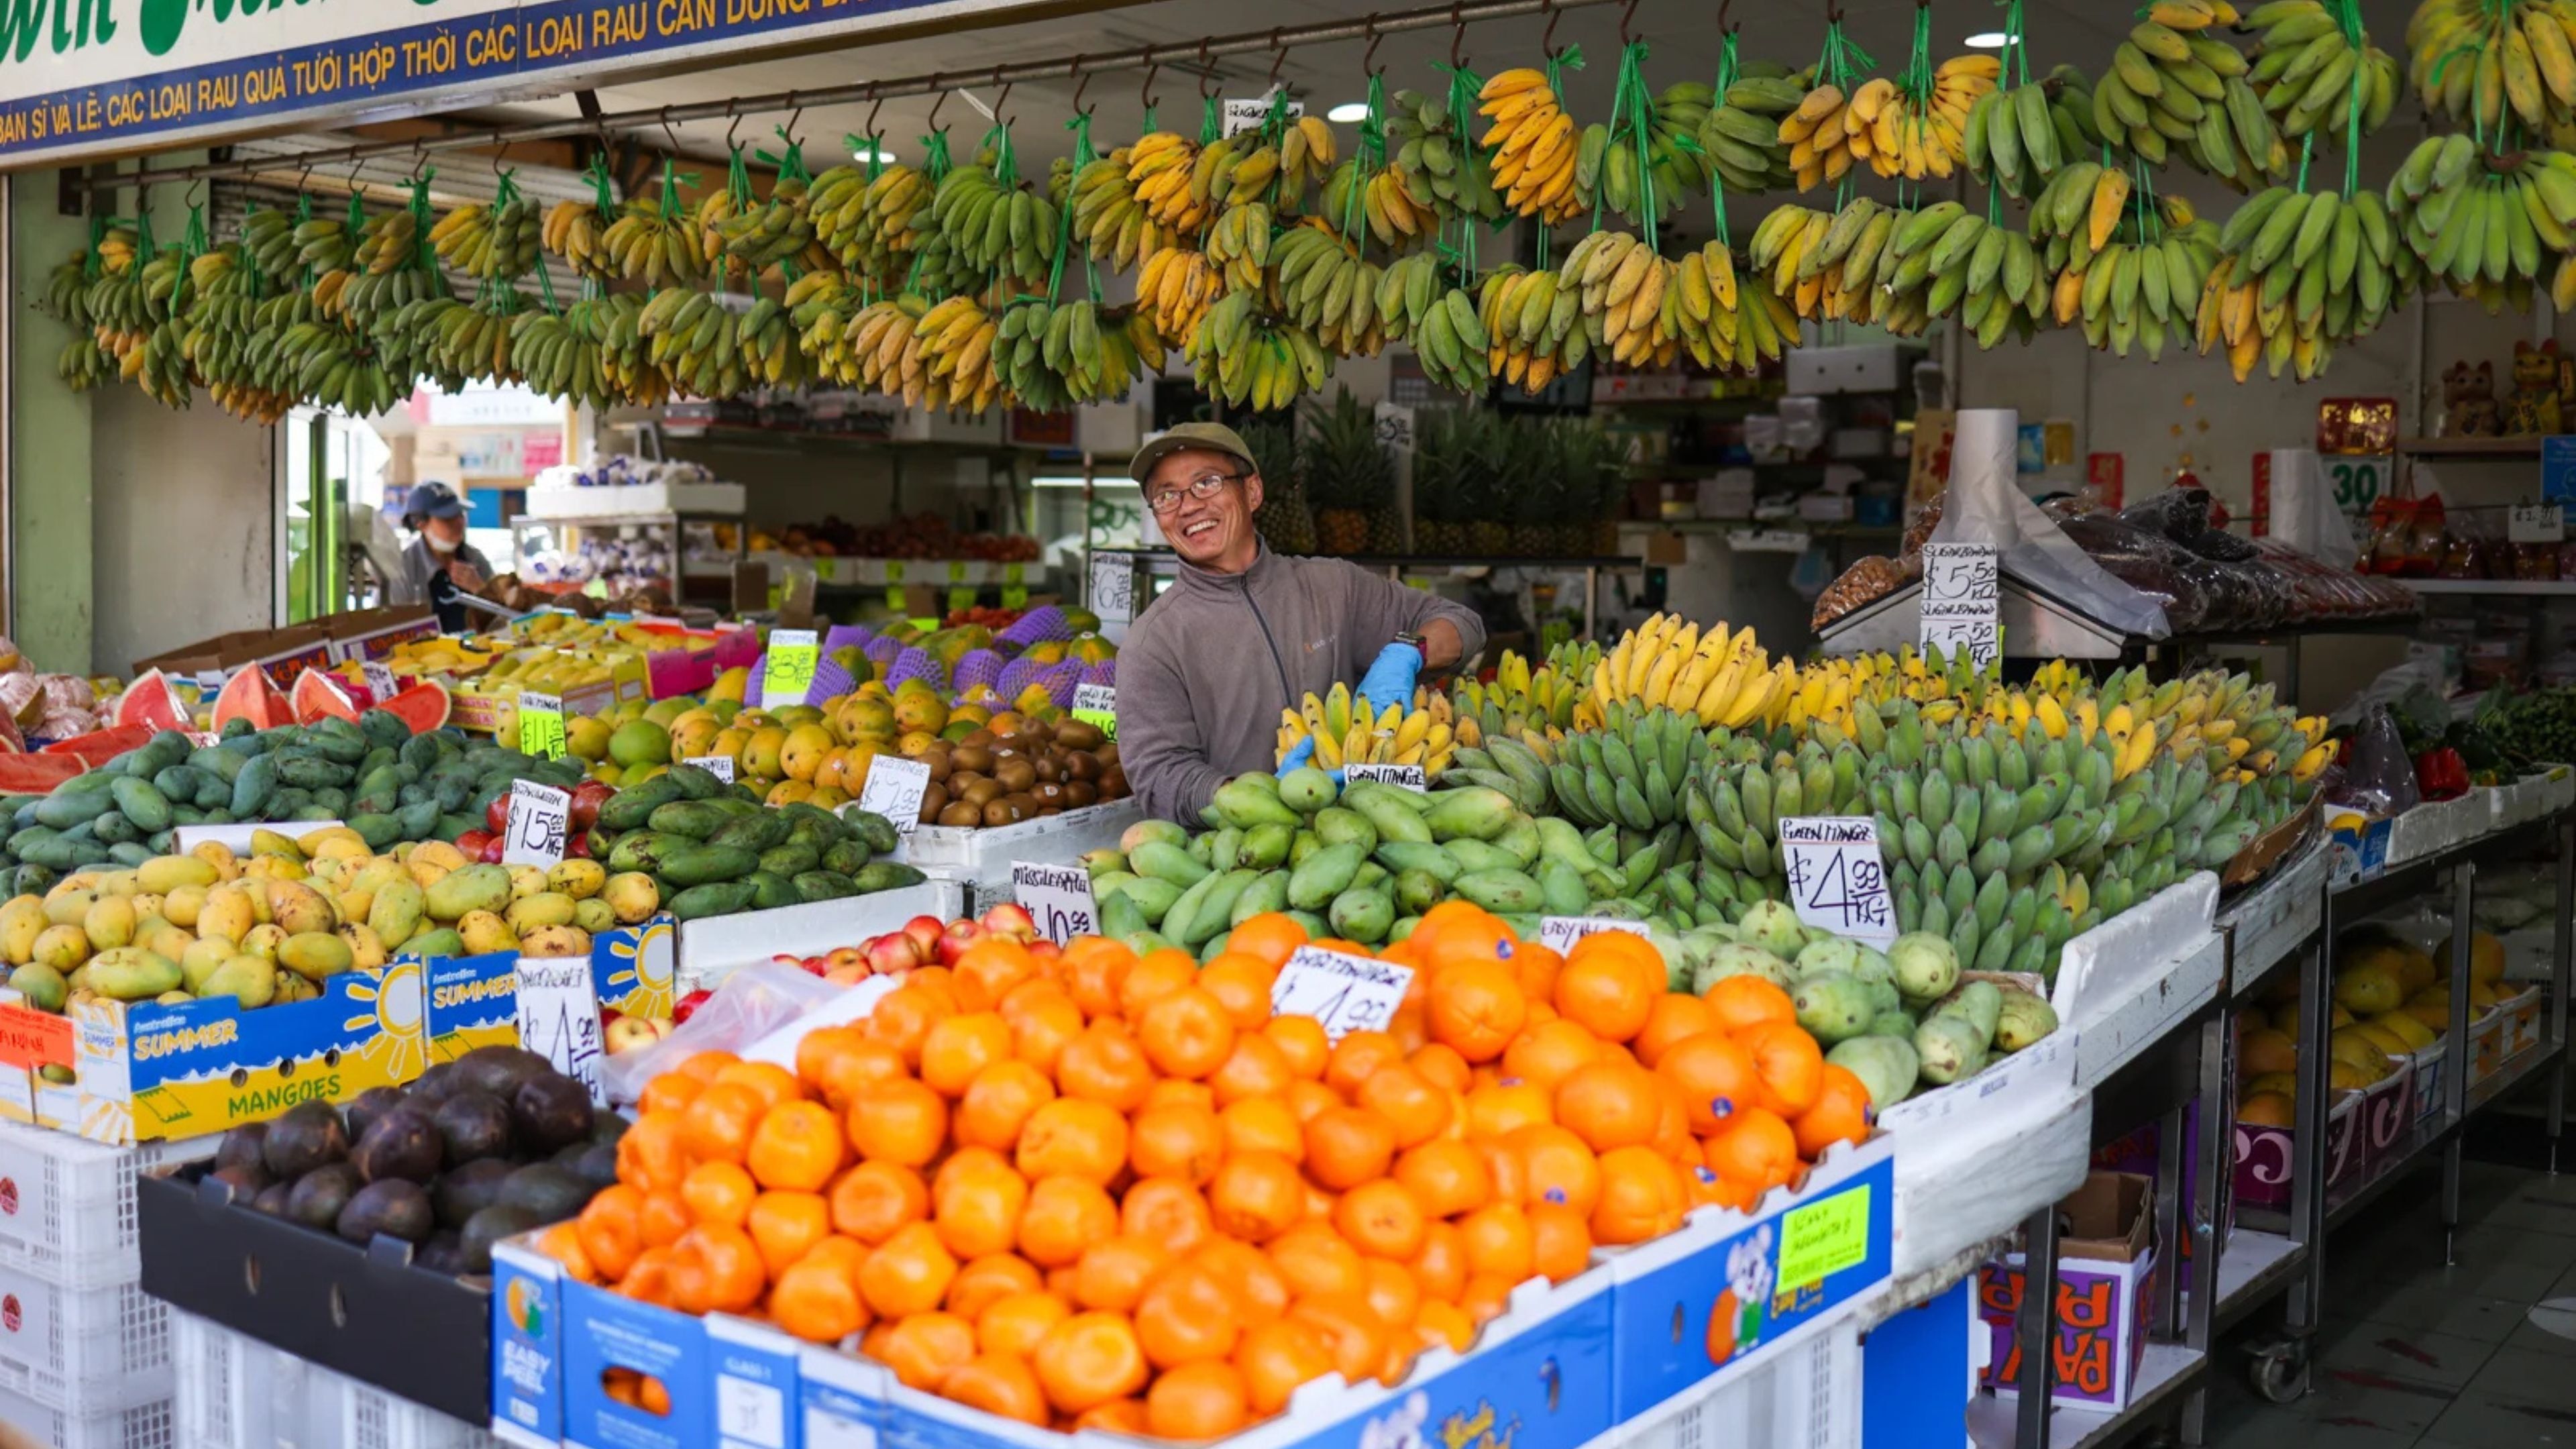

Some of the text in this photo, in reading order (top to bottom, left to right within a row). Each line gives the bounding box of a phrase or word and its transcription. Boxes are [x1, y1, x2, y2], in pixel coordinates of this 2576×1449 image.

[150, 83, 191, 121] LOẠI
[198, 74, 237, 111] RAU
[244, 54, 286, 104] QUẢ
[402, 26, 456, 77] THỜI
[466, 14, 516, 66] CÁC
[527, 13, 583, 59] LOẠI
[593, 2, 647, 47] RAU
[2332, 464, 2377, 505] 30
[134, 1018, 238, 1061] SUMMER
[229, 1074, 341, 1119] MANGOES
